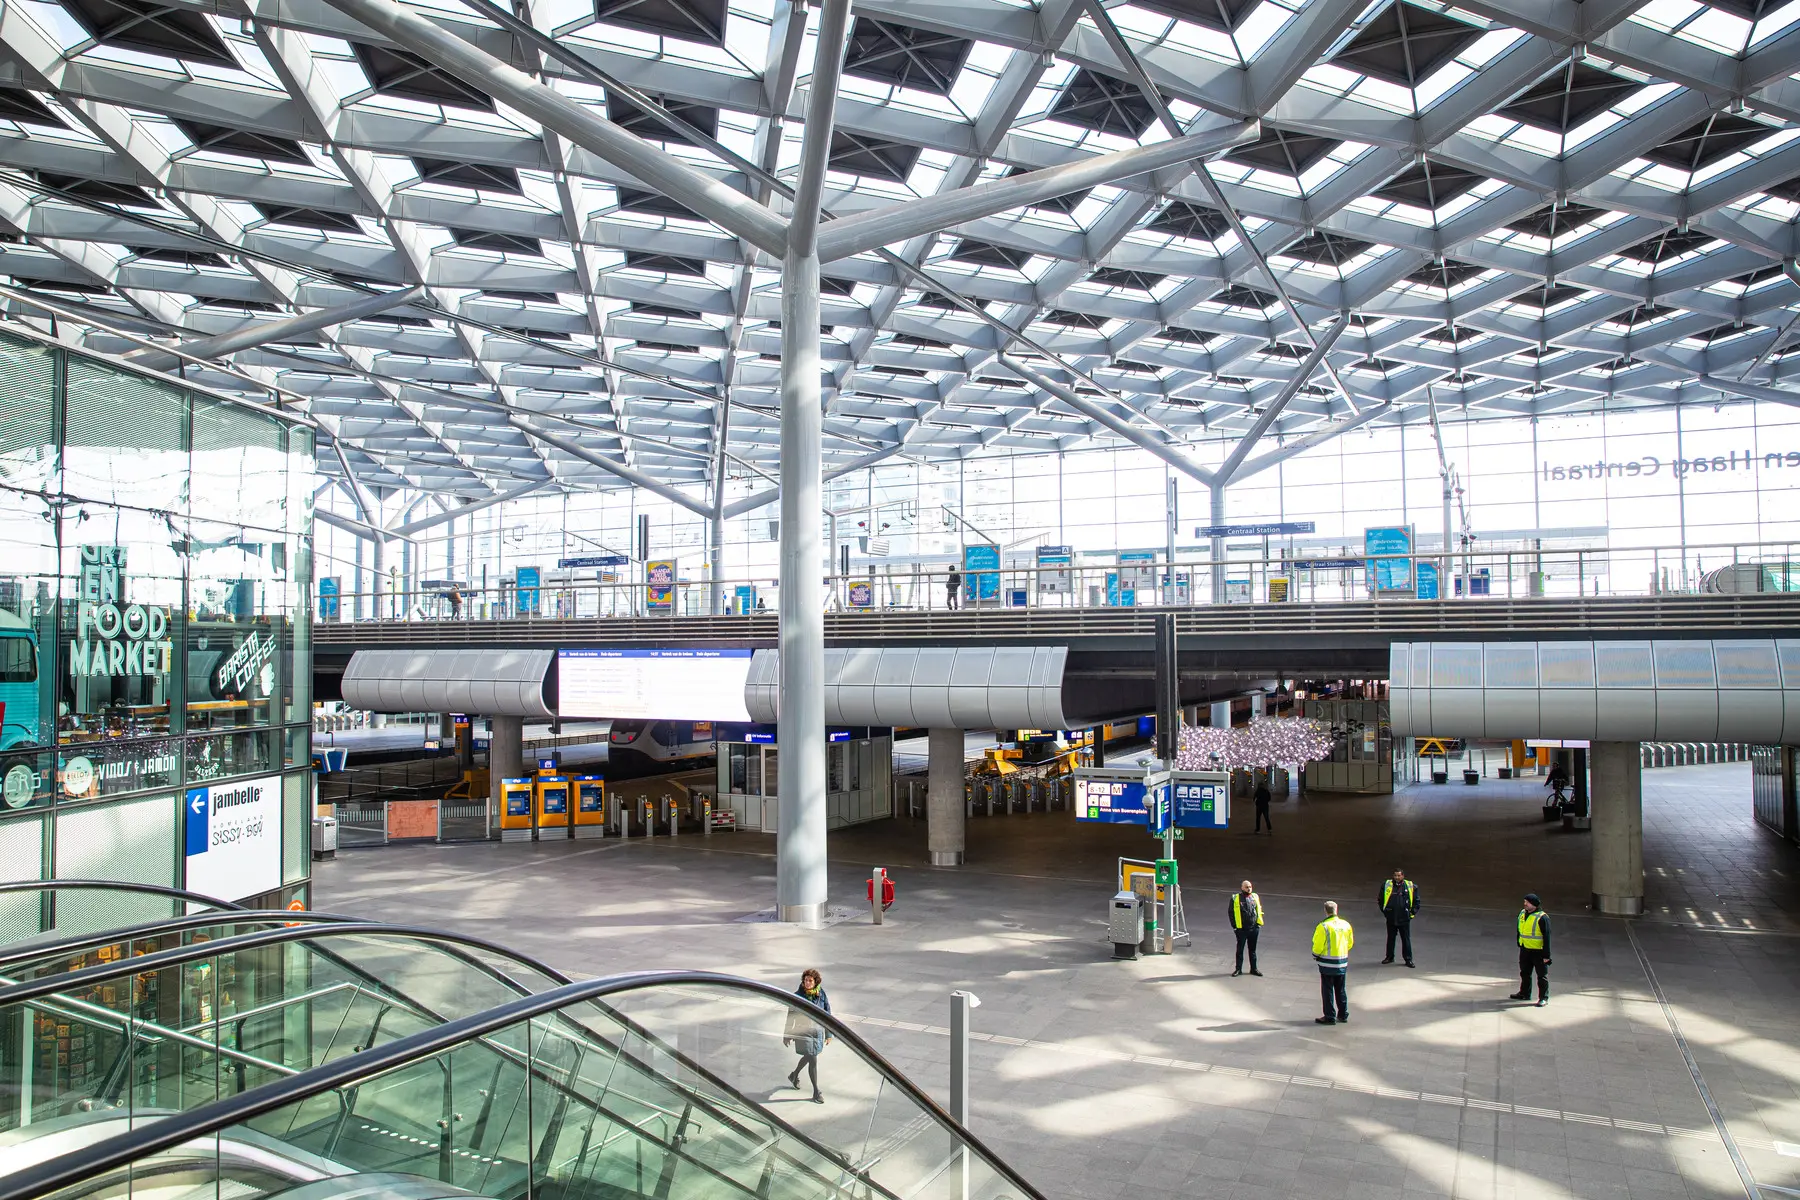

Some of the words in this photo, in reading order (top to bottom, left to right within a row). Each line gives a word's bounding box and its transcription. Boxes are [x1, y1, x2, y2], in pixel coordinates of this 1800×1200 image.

[1227, 527, 1255, 535] Centraal
[1256, 526, 1281, 534] Station
[78, 603, 167, 640] FOOD
[69, 640, 174, 676] MARKET
[218, 630, 260, 690] BARISTA
[235, 633, 277, 693] COFFEE
[0, 770, 41, 793] ERS
[99, 760, 132, 780] VINOS
[1112, 786, 1121, 794] M
[212, 814, 263, 829] HOMELAND
